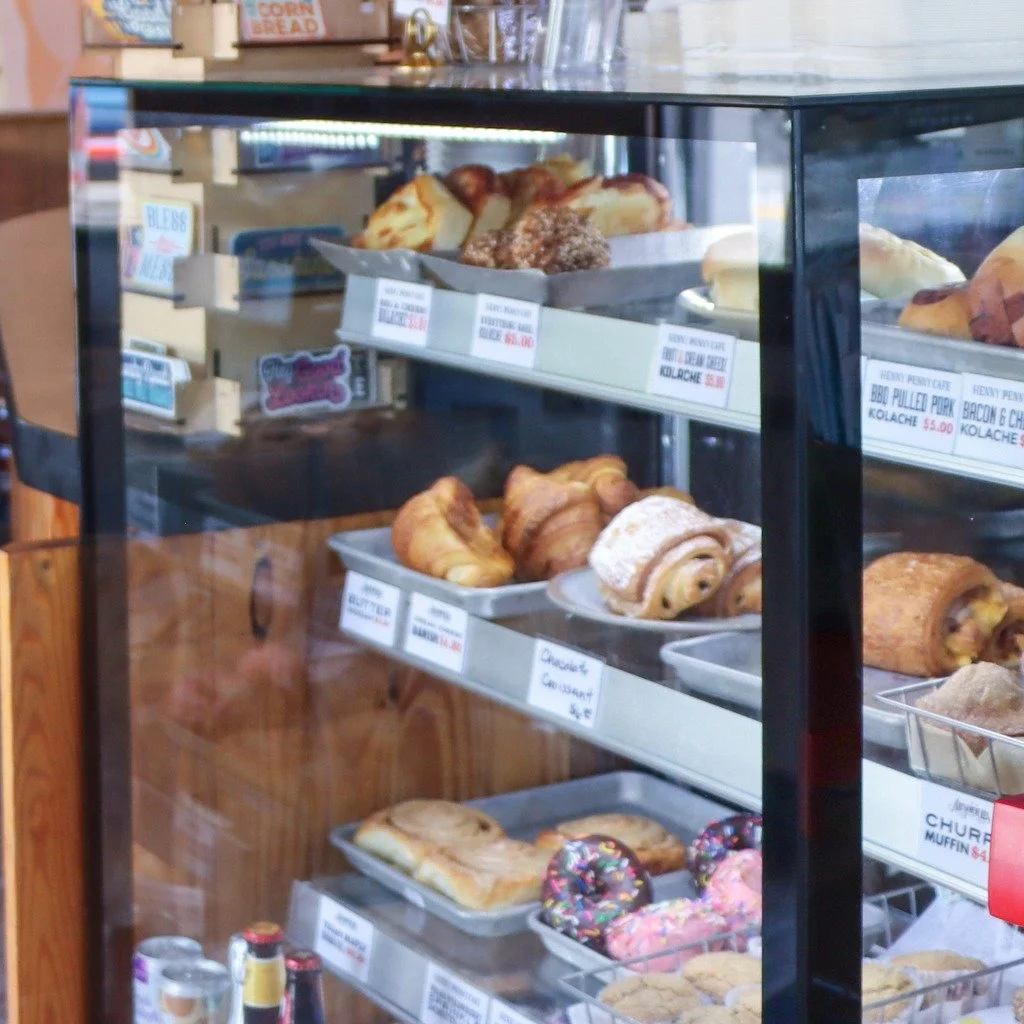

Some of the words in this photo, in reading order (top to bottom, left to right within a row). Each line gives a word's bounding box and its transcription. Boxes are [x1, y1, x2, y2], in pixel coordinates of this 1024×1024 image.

[257, 2, 314, 17] CORN
[251, 17, 318, 35] BREAD
[659, 365, 702, 384] KOLACHE
[881, 370, 905, 383] HENNY
[907, 375, 931, 388] PENNY
[932, 379, 951, 391] CAFE
[870, 384, 889, 406] BBQ
[892, 388, 928, 412] PULLED
[931, 395, 956, 417] PORK
[973, 384, 999, 398] HENNY
[868, 407, 918, 427] KOLACHE
[923, 418, 953, 435] $5.00
[962, 400, 997, 425] BACON
[1000, 407, 1006, 426] &
[1009, 409, 1024, 430] CH
[960, 422, 1018, 445] KOLACHE
[925, 830, 970, 855] MUFFIN
